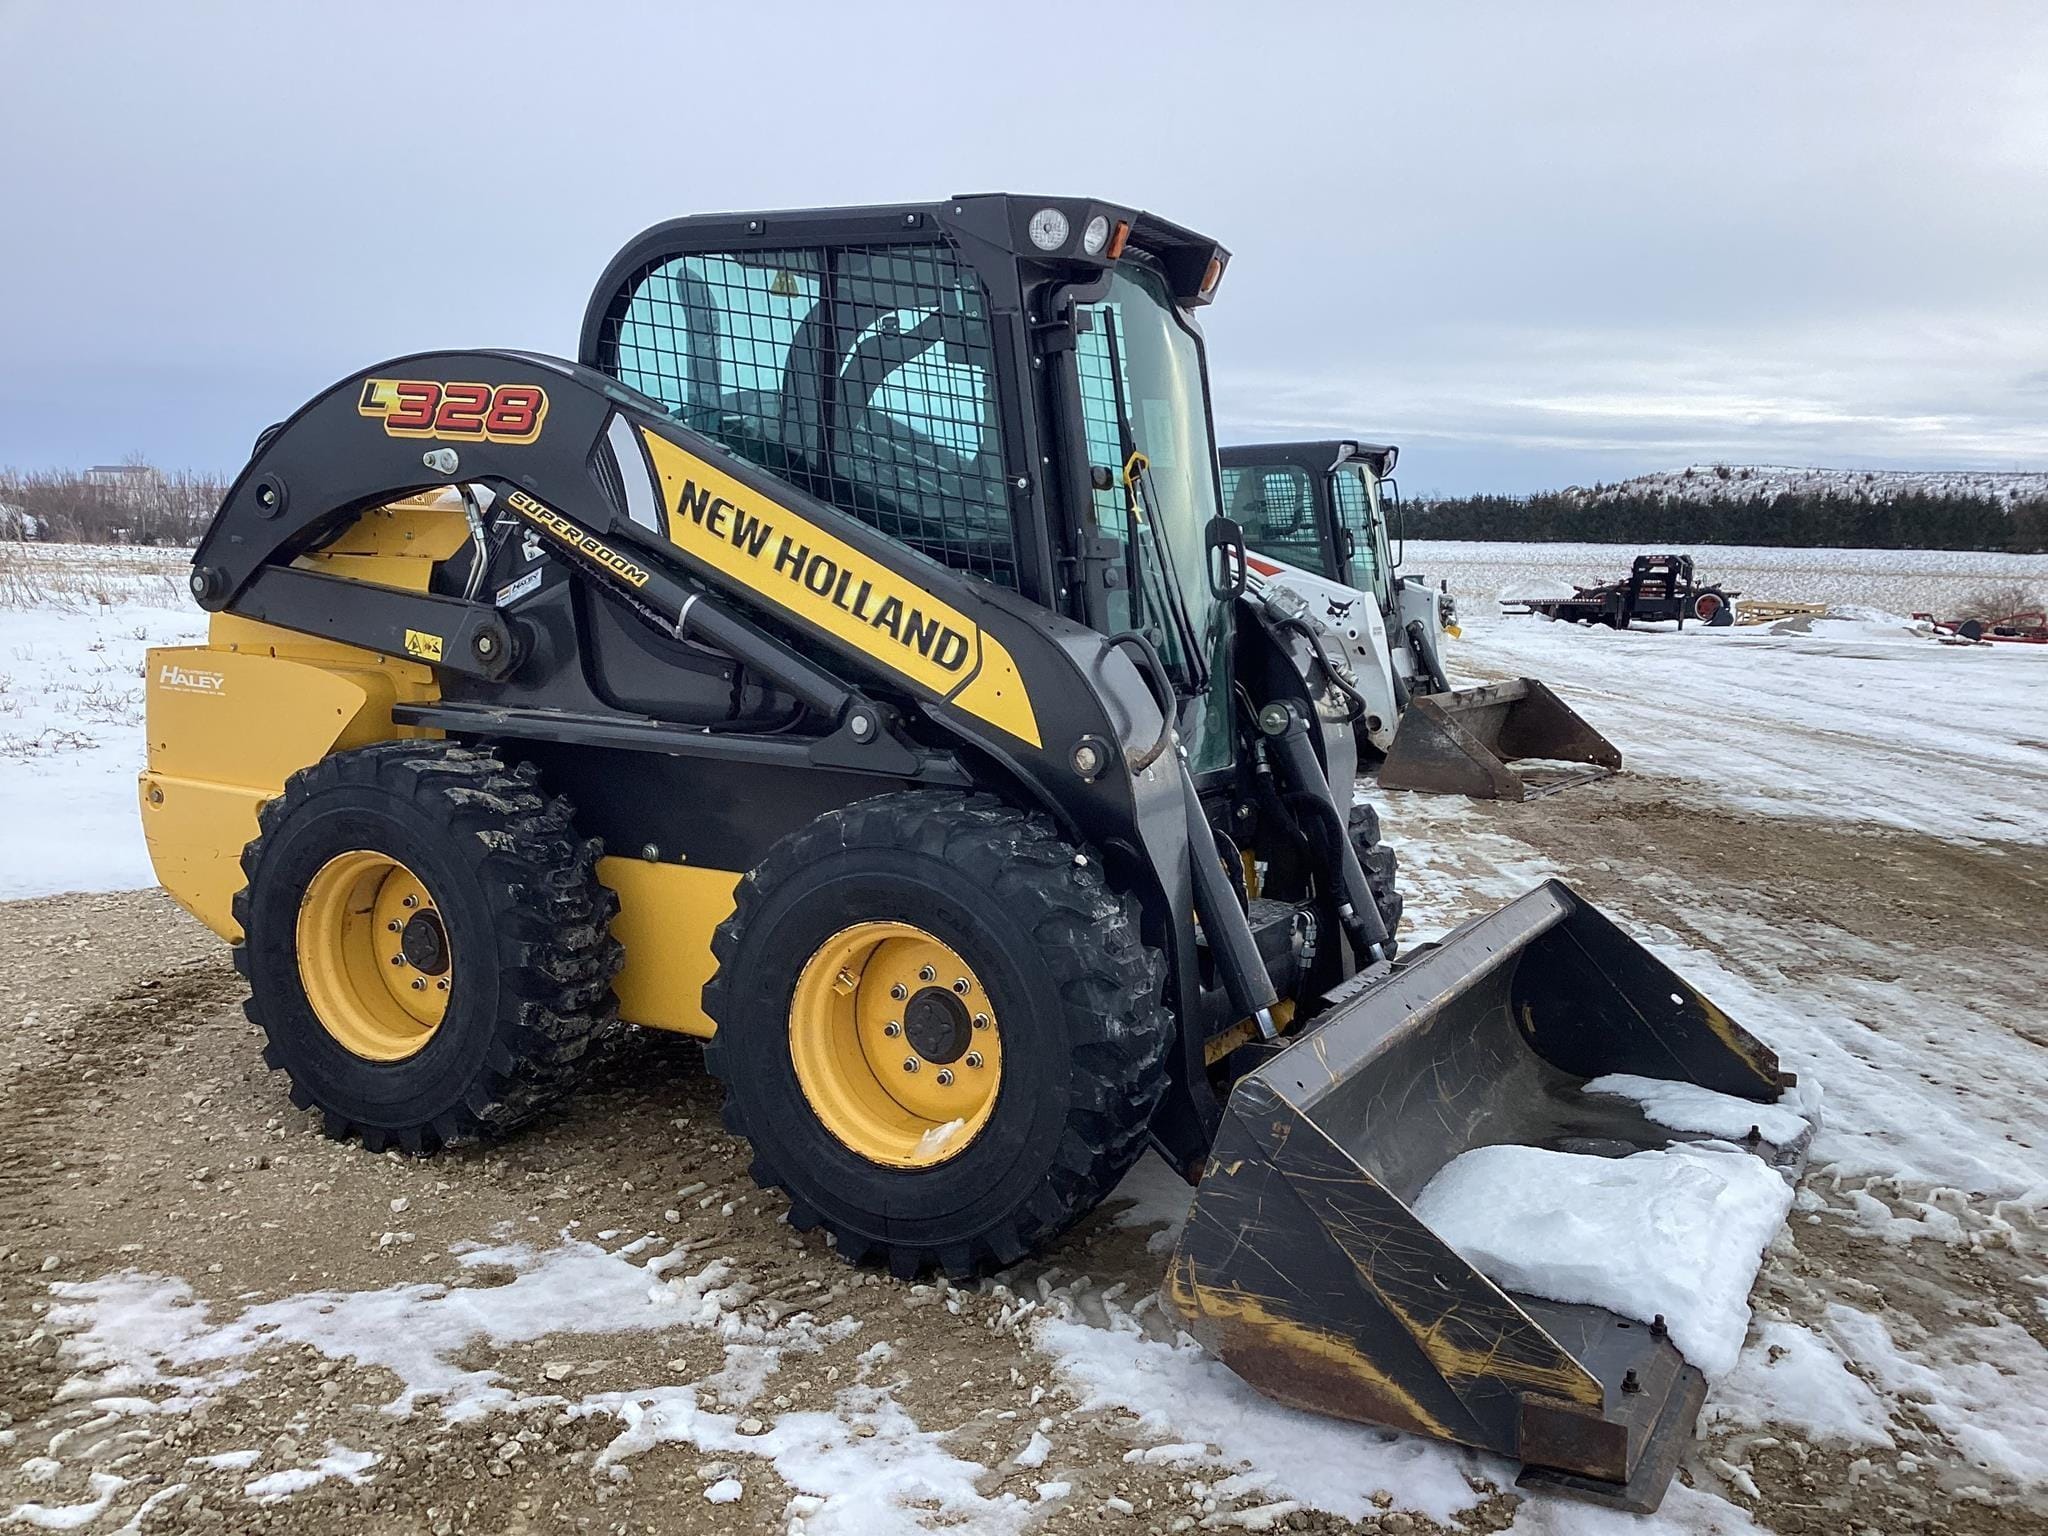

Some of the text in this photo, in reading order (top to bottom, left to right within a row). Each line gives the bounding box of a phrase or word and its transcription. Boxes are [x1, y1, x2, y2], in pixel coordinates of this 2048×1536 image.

[359, 380, 548, 443] L328
[676, 479, 969, 673] NEW HOLLAND
[160, 664, 225, 690] HALEY
